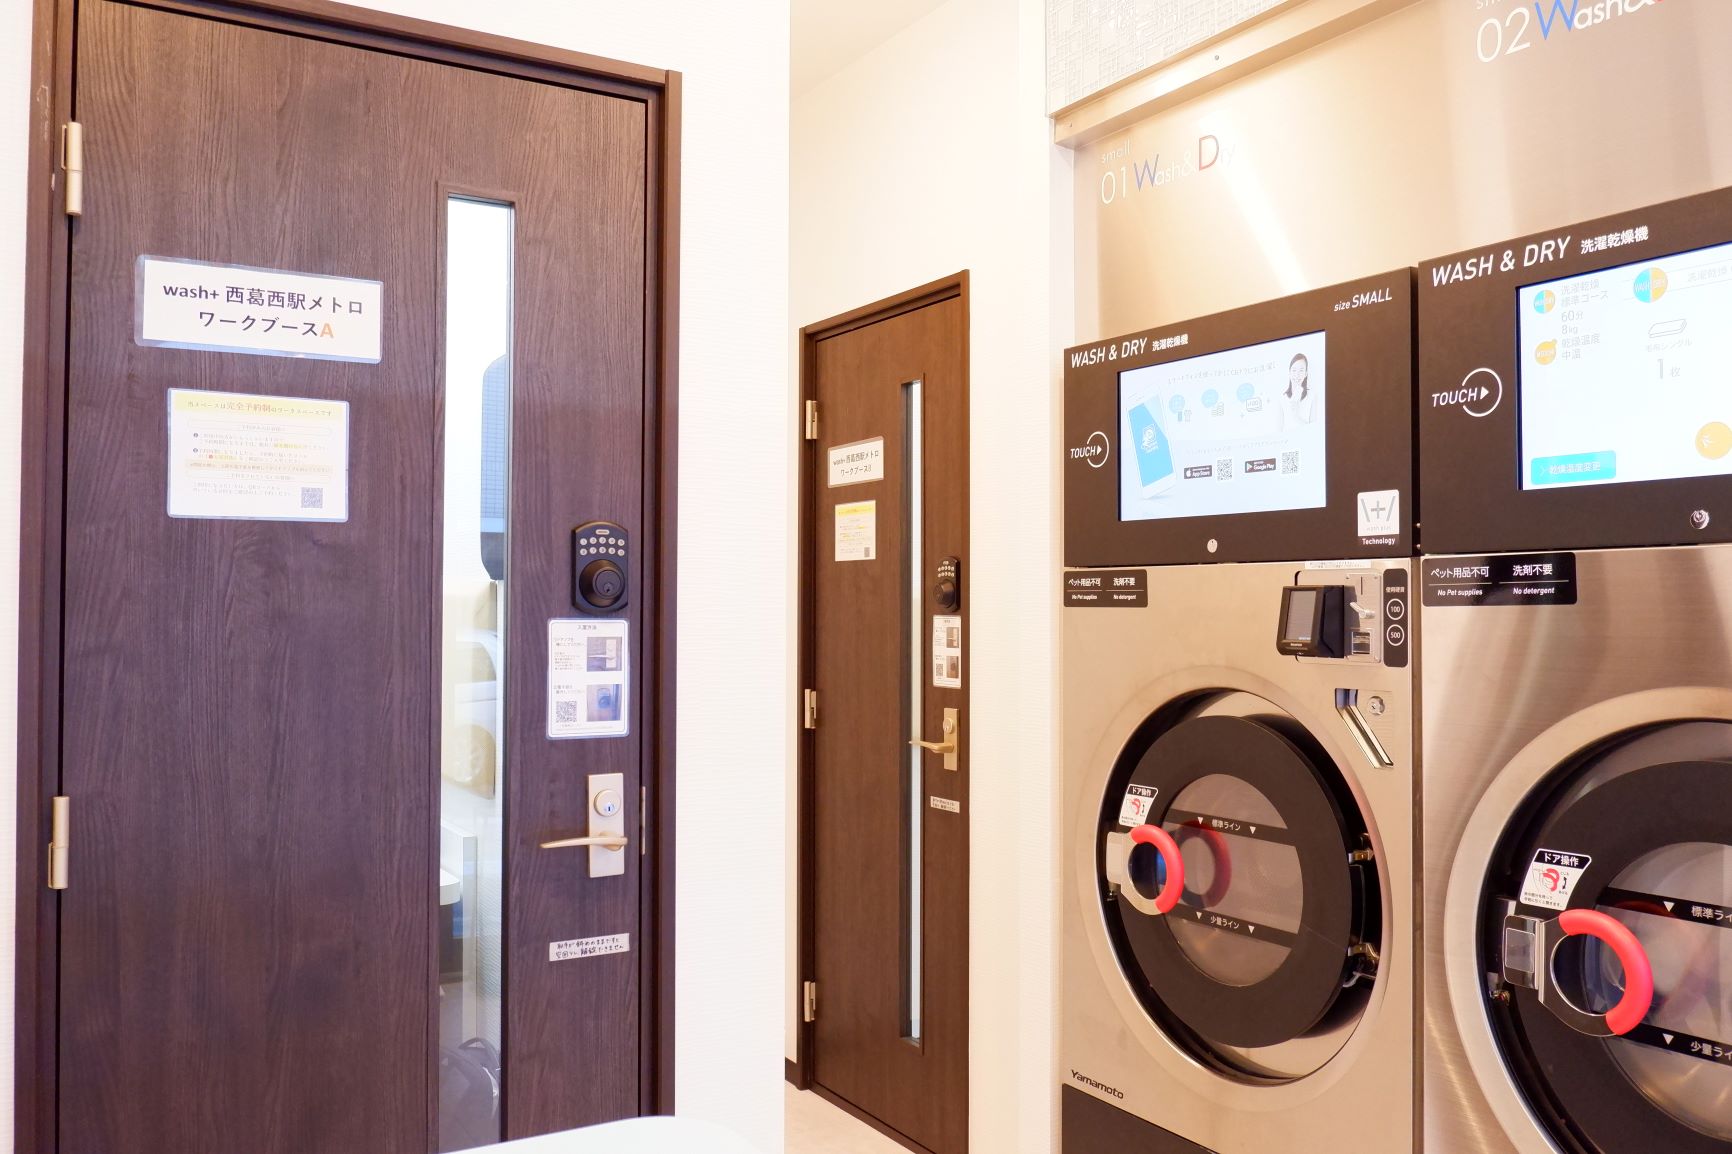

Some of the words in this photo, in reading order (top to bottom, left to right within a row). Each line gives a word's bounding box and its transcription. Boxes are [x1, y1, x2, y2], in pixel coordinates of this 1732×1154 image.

[1476, 7, 1530, 63] 02
[1102, 139, 1132, 164] small
[1100, 166, 1127, 205] 01
[1432, 254, 1492, 287] WASH
[1500, 249, 1516, 272] &
[1523, 236, 1572, 268] DRY
[1580, 226, 1649, 255] 洗濯乾燥機
[162, 284, 220, 300] wash+
[226, 285, 363, 315] 西葛西駅メトロ
[1334, 301, 1350, 312] size
[1352, 288, 1393, 308] SMALL
[198, 310, 335, 339] ワークブースA
[1071, 348, 1106, 368] WASH
[1108, 344, 1118, 361] &
[1121, 337, 1148, 358] DRY
[1152, 334, 1189, 352] 洗濯乾燥機
[1432, 386, 1478, 407] TOUCH
[1070, 445, 1097, 459] TOUCH
[1362, 537, 1396, 546] Technology
[1430, 566, 1490, 578] ペット用品不可
[1512, 564, 1553, 576] 洗剤不要
[1068, 577, 1101, 587] ペット用品不可
[1113, 577, 1136, 586] 洗剤不要
[1458, 589, 1483, 597] supplies
[1523, 587, 1555, 596] detergent
[1132, 787, 1152, 797] ドア操作
[1211, 818, 1241, 831] 標準ライン
[1544, 852, 1579, 867] ドア操作
[1210, 916, 1240, 929] 少量ライン
[1070, 1069, 1124, 1100] Yamamoto
